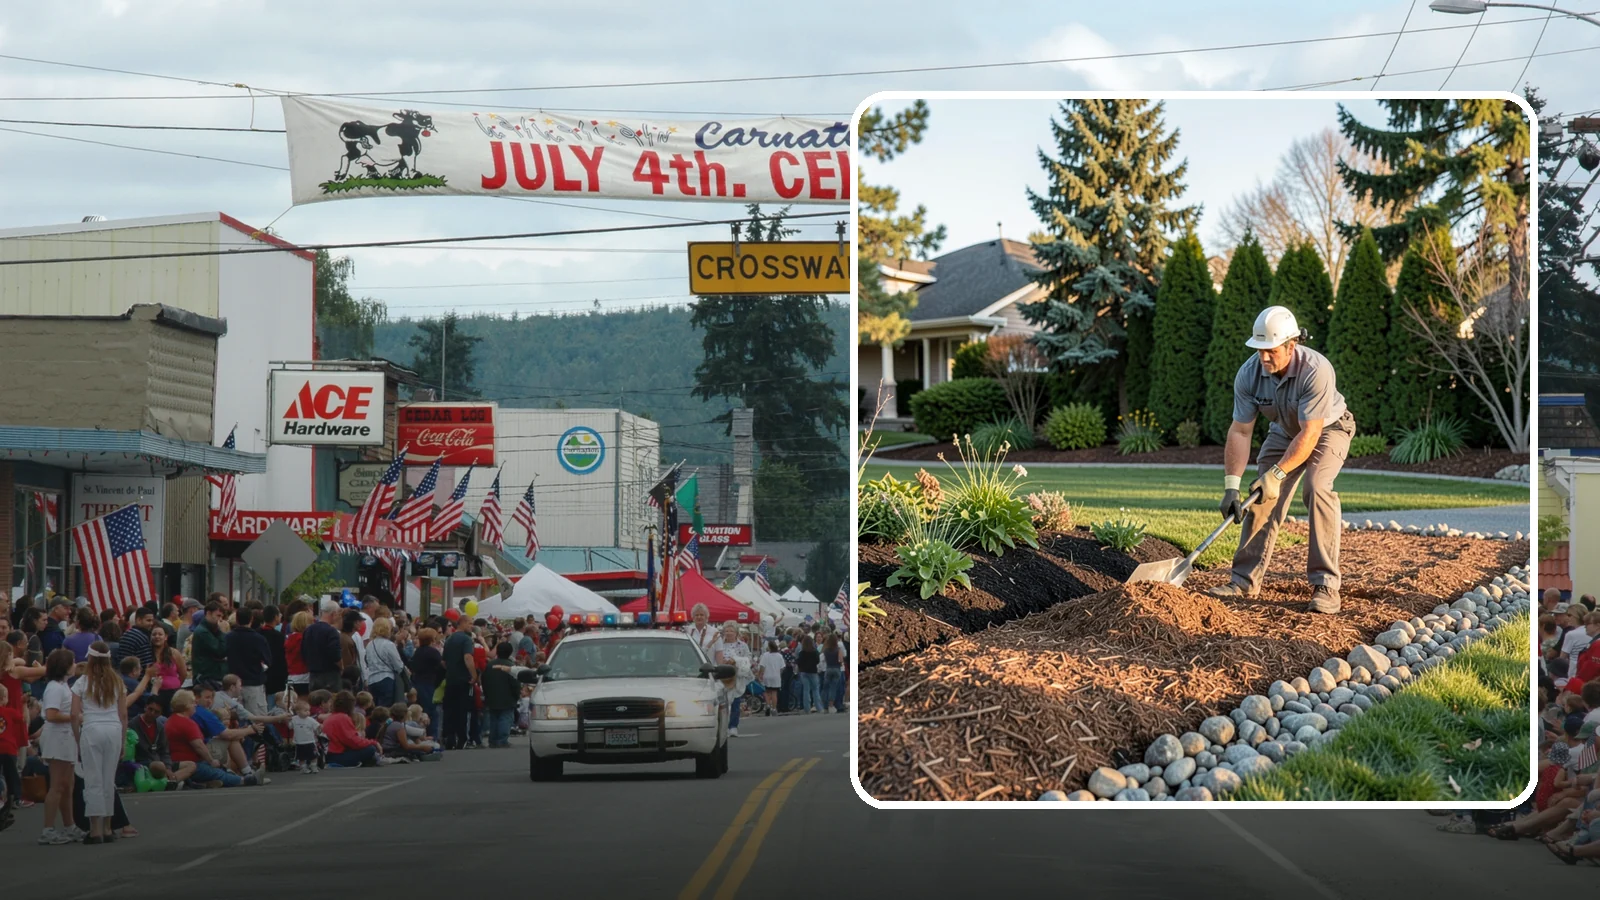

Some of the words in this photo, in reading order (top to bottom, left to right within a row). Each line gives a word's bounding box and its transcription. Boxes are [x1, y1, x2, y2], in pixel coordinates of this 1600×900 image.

[481, 140, 604, 193] JULY
[632, 150, 746, 197] 4th.
[697, 253, 850, 280] CROSSWA
[283, 380, 373, 420] ACE
[405, 409, 452, 421] CEDAR
[460, 409, 485, 421] LOG
[283, 421, 371, 437] Hardware
[416, 427, 477, 447] Coca-Cola
[353, 466, 386, 480] Simpl
[83, 485, 93, 494] St.
[95, 485, 124, 495] Vincent
[126, 486, 136, 495] de
[137, 486, 155, 495] Paul
[212, 515, 331, 535] HARDARE
[688, 526, 741, 535] CRNATION
[699, 535, 730, 543] GLASS
